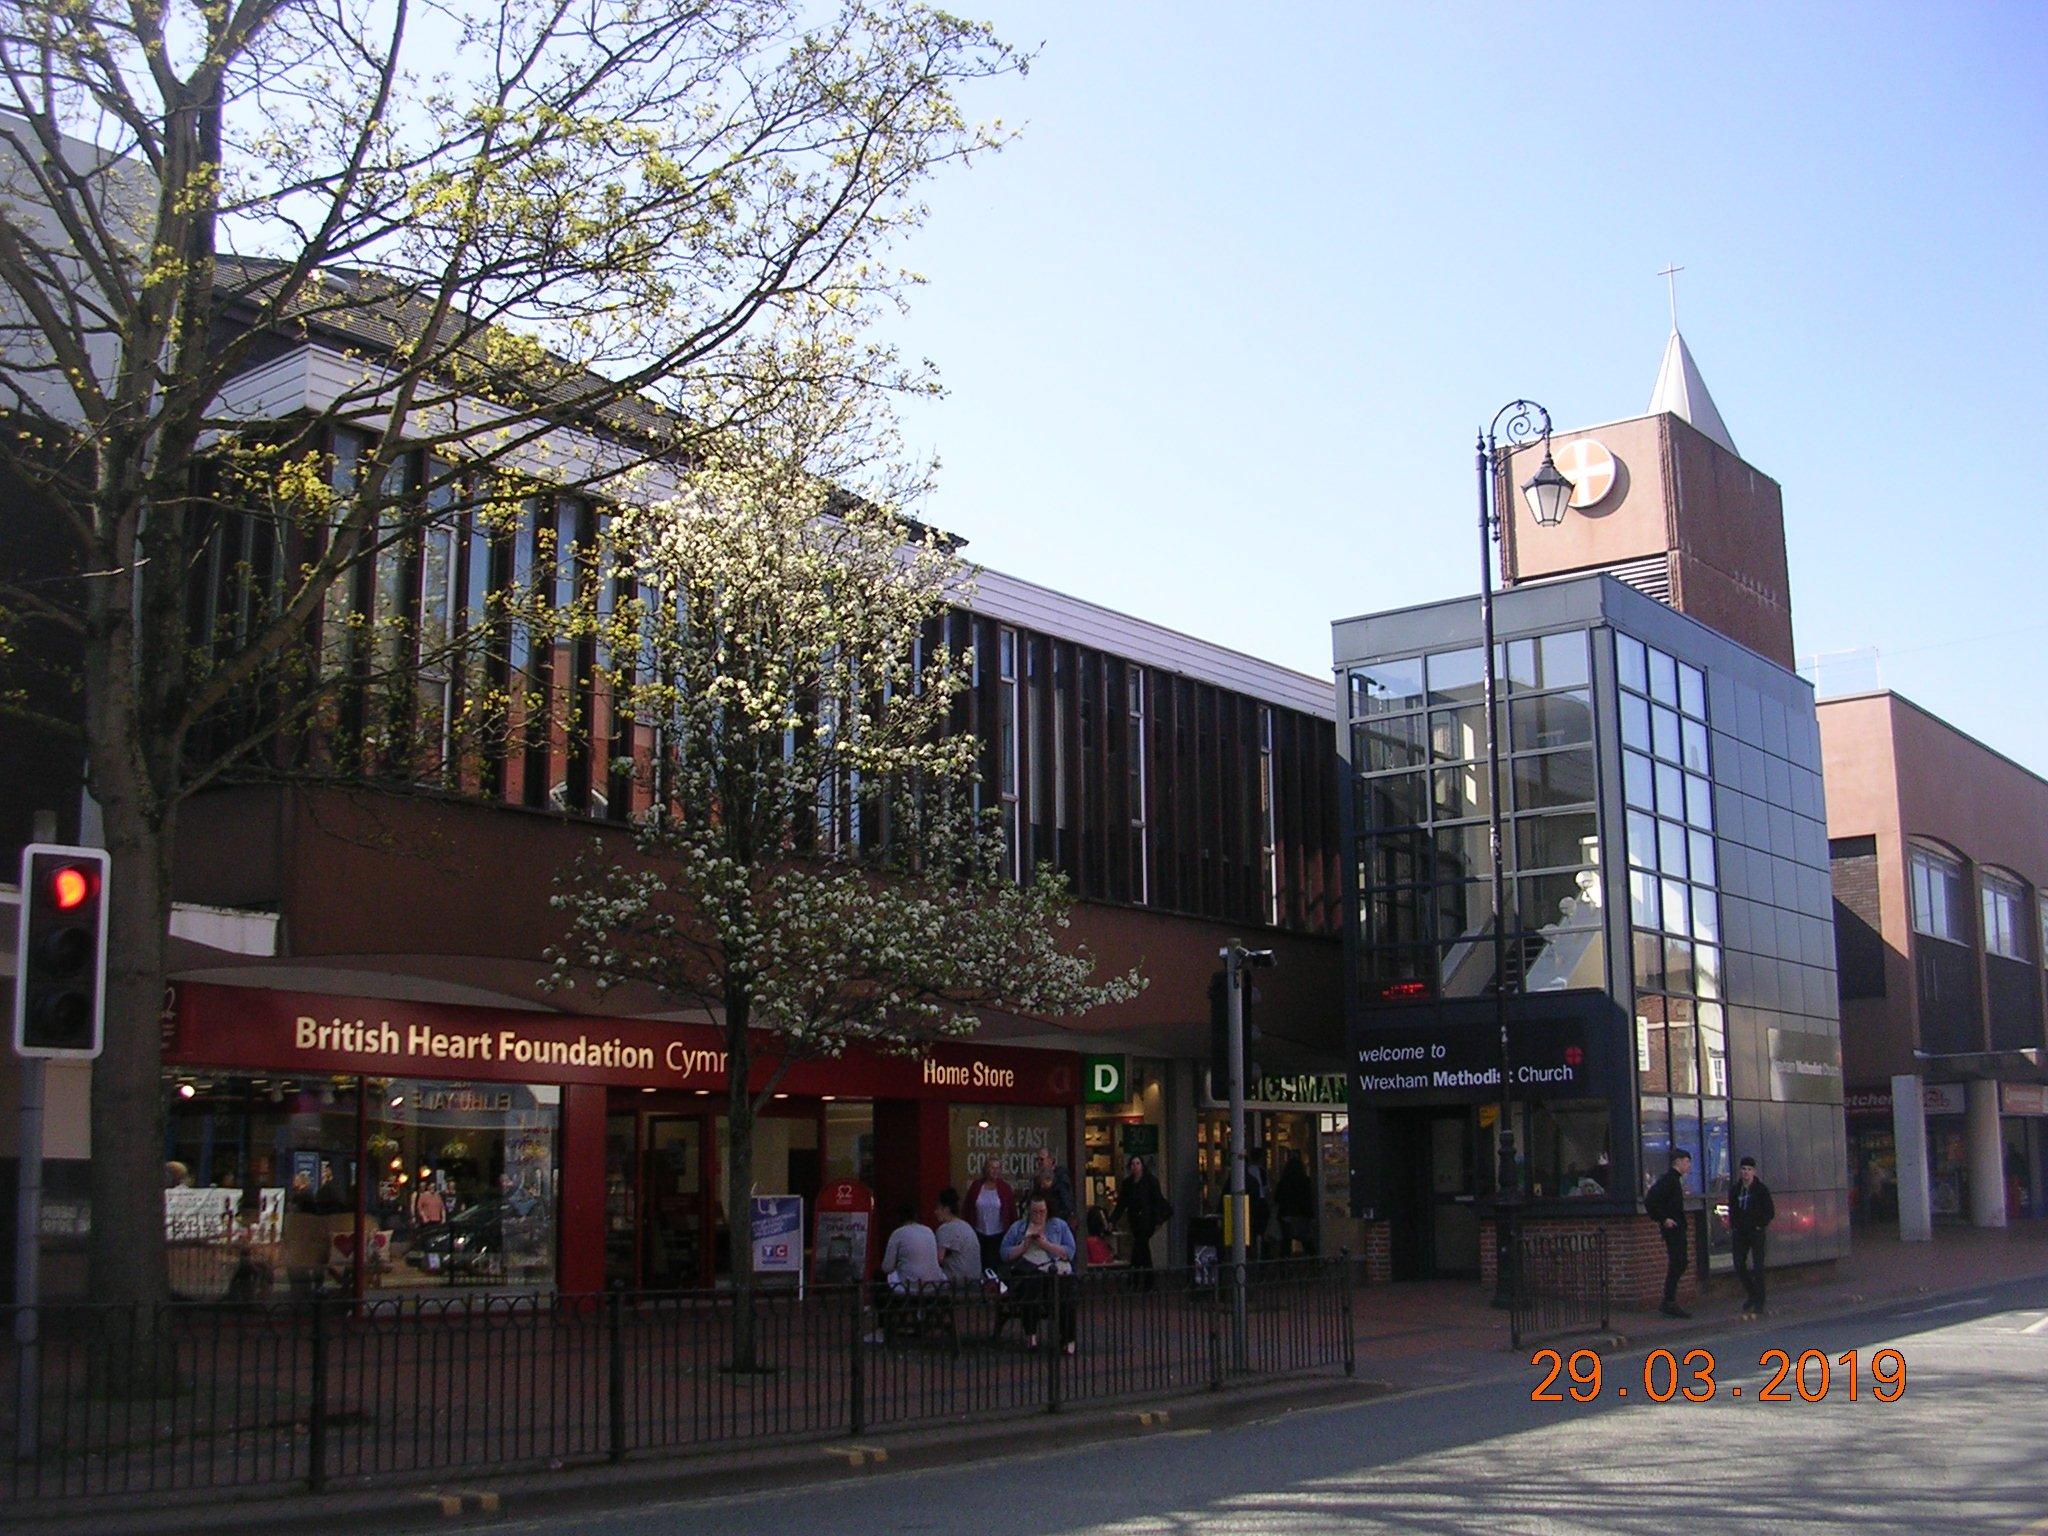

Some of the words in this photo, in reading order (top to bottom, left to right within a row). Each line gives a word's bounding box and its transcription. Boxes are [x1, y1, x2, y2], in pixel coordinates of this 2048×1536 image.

[295, 1016, 400, 1055] British
[408, 1024, 493, 1061] Heart
[498, 1031, 655, 1070] Foundation
[666, 1041, 729, 1079] Cymr
[1358, 1045, 1425, 1063] welcome
[1431, 1043, 1446, 1059] to
[923, 1056, 969, 1086] Home
[973, 1060, 1015, 1088] Store
[1094, 1063, 1119, 1094] D
[1359, 1073, 1428, 1091] Wrexham
[1433, 1067, 1514, 1087] Methodi
[1518, 1064, 1573, 1083] Church
[1247, 1072, 1348, 1103] ICHMAN
[966, 1126, 1000, 1148] FREE
[1004, 1126, 1016, 1148] &
[1017, 1126, 1049, 1148] FAST
[967, 1151, 1044, 1174] COECTIO
